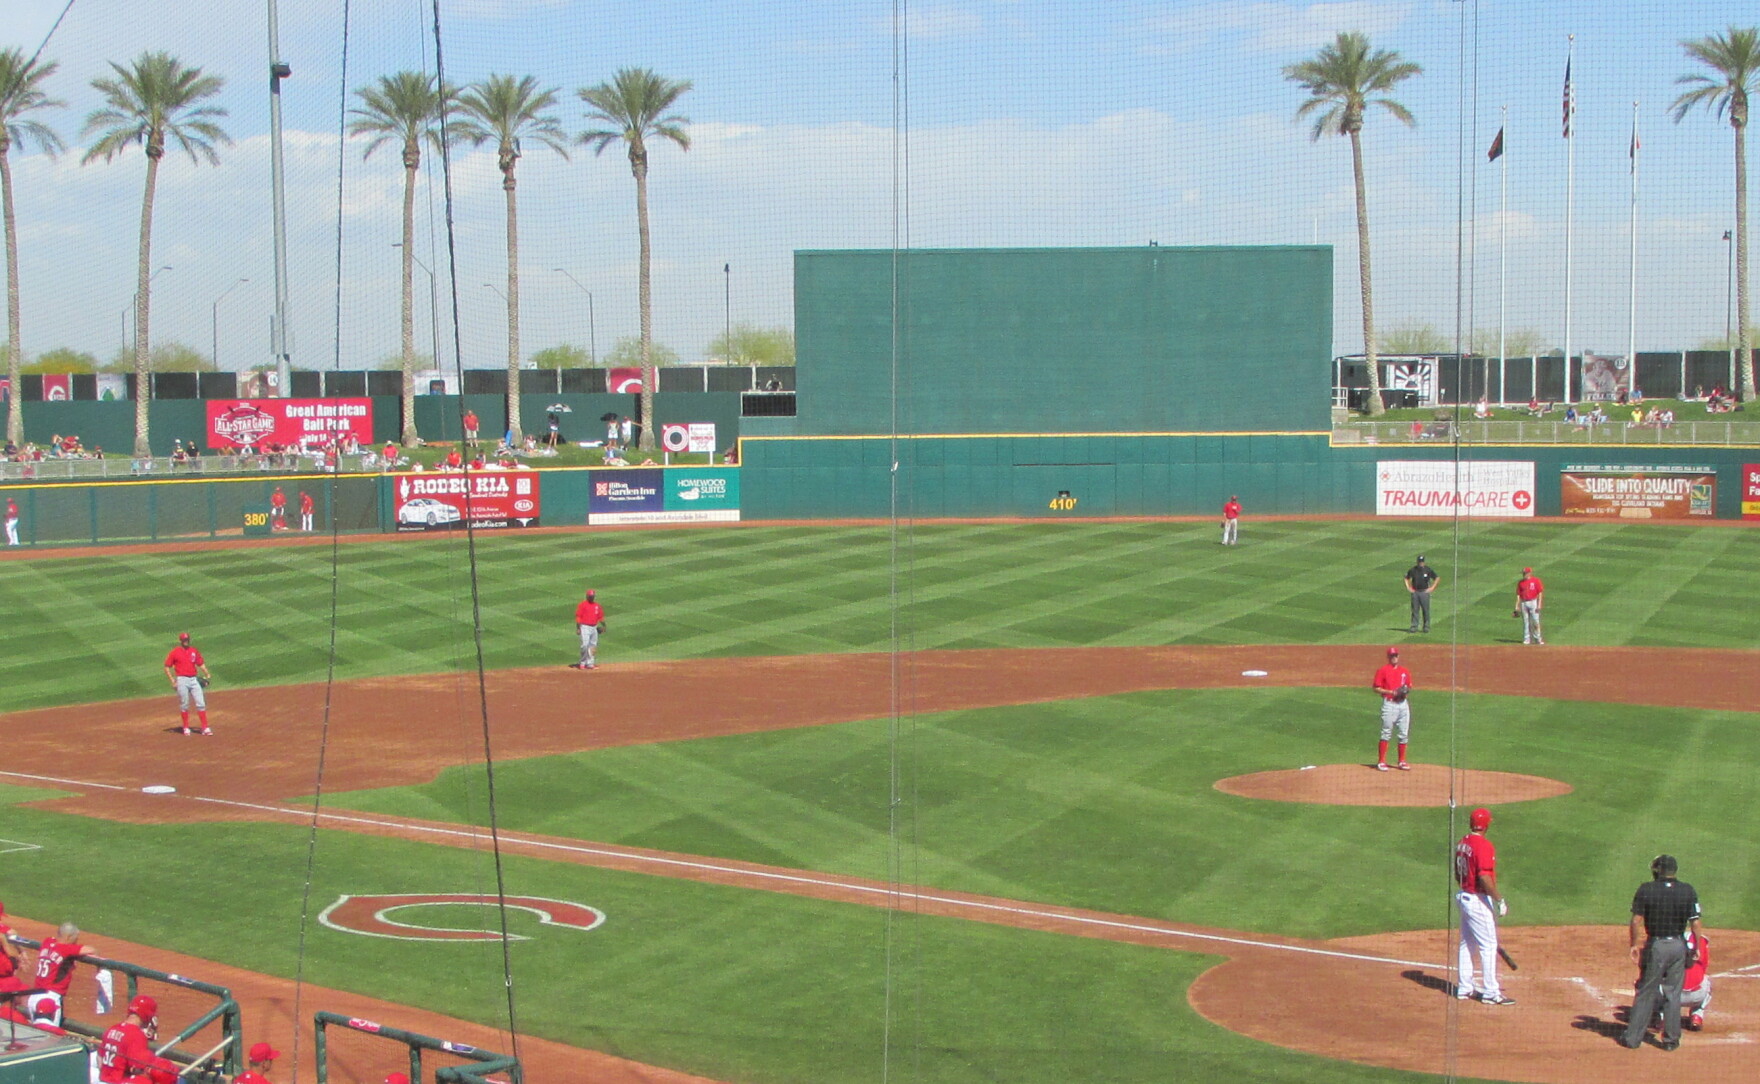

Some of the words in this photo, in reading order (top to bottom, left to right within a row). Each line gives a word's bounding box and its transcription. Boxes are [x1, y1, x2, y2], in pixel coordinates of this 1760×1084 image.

[286, 405, 315, 417] Great
[317, 404, 366, 416] American
[252, 417, 275, 430] GAME
[303, 418, 324, 431] Ball
[326, 418, 350, 430] Park
[413, 478, 471, 494] RODEO
[476, 477, 510, 492] KIA
[677, 479, 726, 487] HOMEWOOD
[1585, 478, 1614, 493] SLIDE
[1616, 479, 1642, 494] INTO
[1643, 478, 1692, 495] QUALITY
[608, 487, 639, 496] Garden
[640, 487, 656, 495] Inn
[700, 486, 726, 494] SUITES
[1384, 490, 1508, 507] TRAUMACARE
[467, 520, 507, 528] odeoKia.com
[103, 1043, 117, 1067] 32
